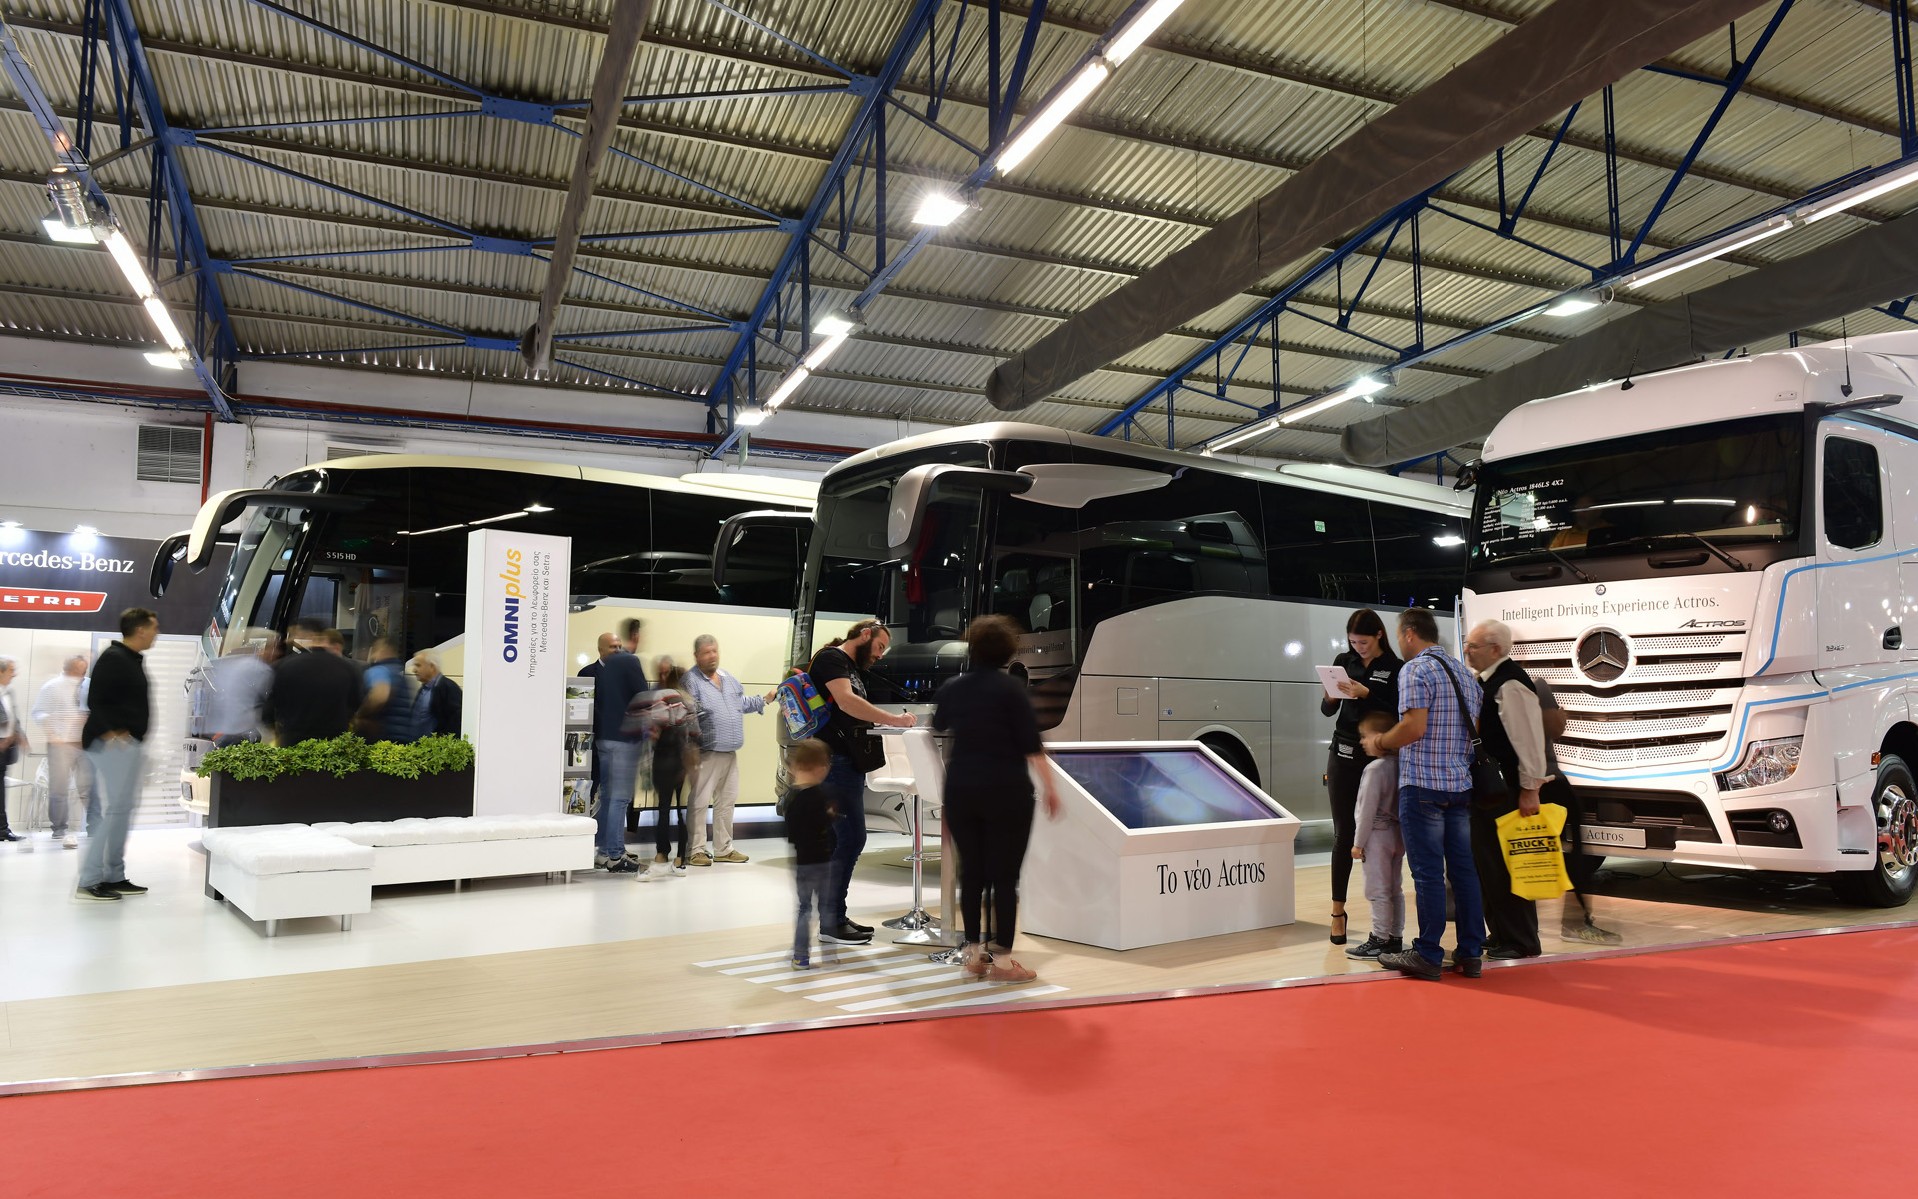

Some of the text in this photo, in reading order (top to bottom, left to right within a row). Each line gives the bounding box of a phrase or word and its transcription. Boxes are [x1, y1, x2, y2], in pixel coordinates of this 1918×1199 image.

[1509, 485, 1528, 493] Actros
[1551, 479, 1564, 487] 4X2
[0, 550, 135, 574] rcedes-Benz
[326, 551, 357, 561] S 515 HD
[542, 552, 551, 576] Setra.
[3, 595, 81, 606] ETRA
[498, 548, 527, 663] OMNIplus
[1501, 595, 1720, 623] Intelligent Driving Experience Actros.
[528, 550, 541, 679] Υπηρεσίες για το λεωφορείο σας
[540, 592, 549, 653] Mercedes-Benz
[1677, 618, 1747, 629] ACTROS
[1509, 839, 1546, 850] TRUCK
[1586, 829, 1624, 842] Actros
[1156, 858, 1266, 895] Το νέο Actros
